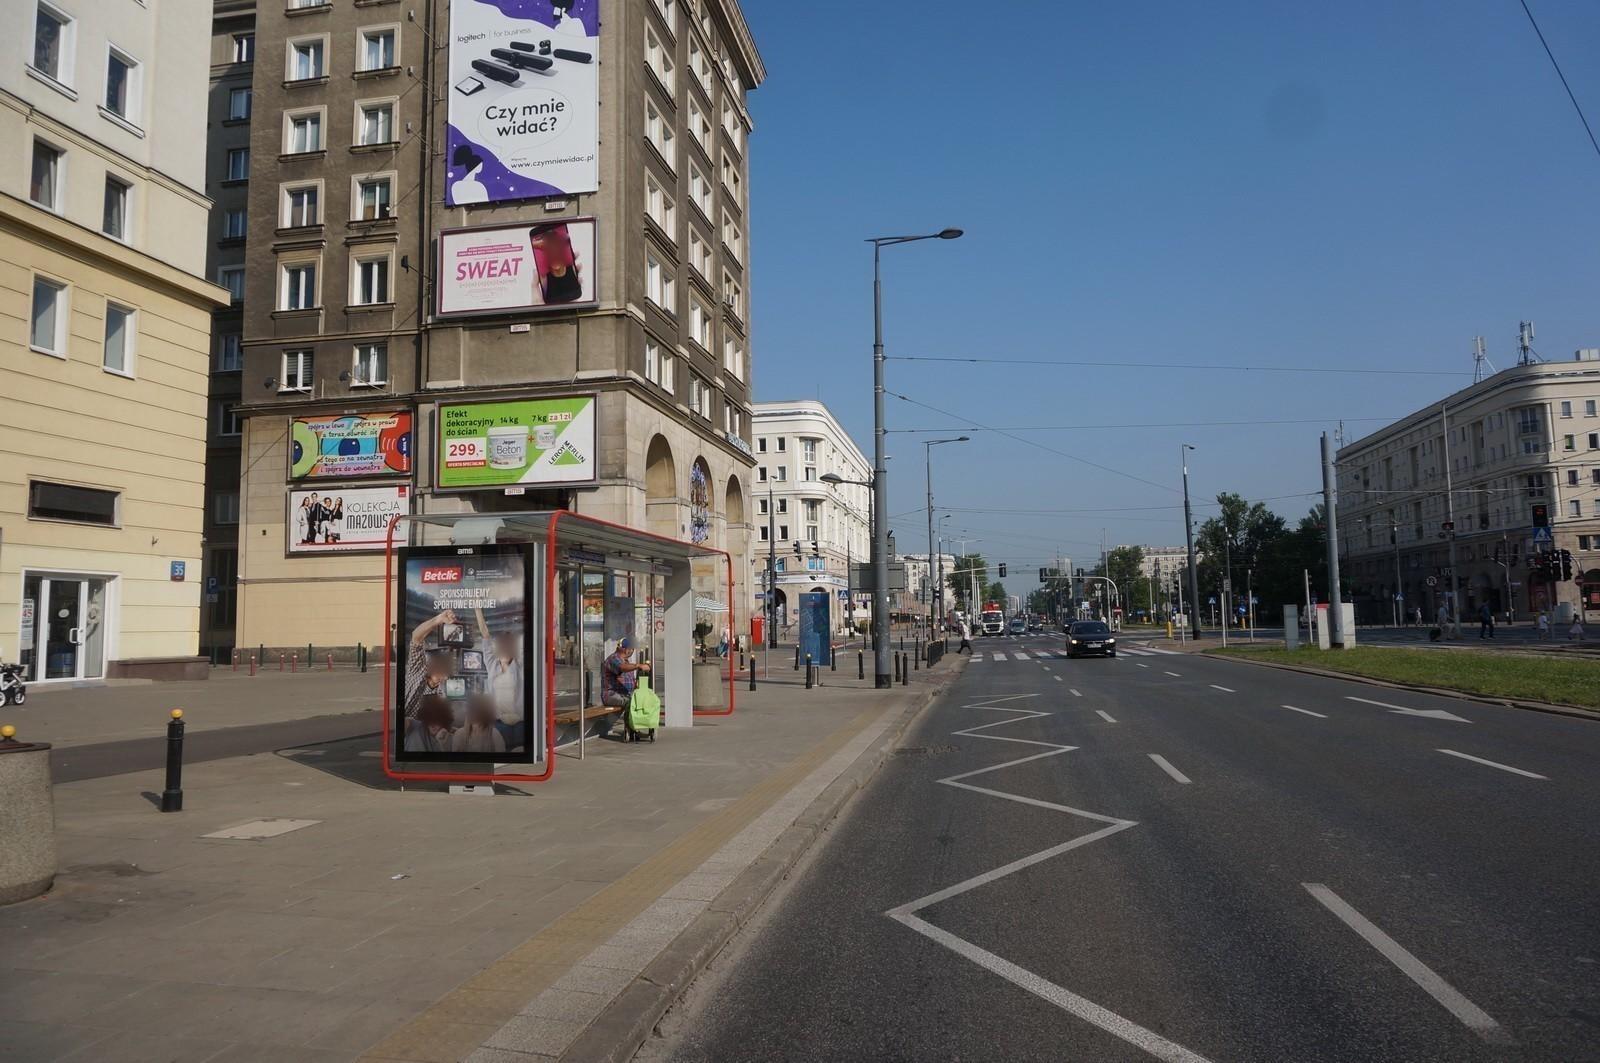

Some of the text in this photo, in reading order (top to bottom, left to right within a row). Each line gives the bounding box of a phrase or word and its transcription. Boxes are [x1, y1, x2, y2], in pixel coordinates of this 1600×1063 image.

[458, 33, 486, 44] logitech
[504, 28, 531, 36] business
[486, 98, 564, 122] Czy mnie
[496, 117, 558, 138] widać?
[511, 154, 594, 168] www.czymniewidac.pl
[456, 258, 523, 281] SWEAT
[446, 418, 494, 427] dekoracyjny
[509, 416, 519, 424] kg
[496, 446, 521, 454] Beton
[548, 440, 586, 465] LEROY MERLIN
[346, 501, 401, 513] KOLEKCJA
[174, 565, 184, 576] 35
[424, 570, 458, 581] Betclic
[439, 588, 490, 598] SPONSORUJEMY
[434, 599, 496, 610] SPORTOWE EMOCJE!
